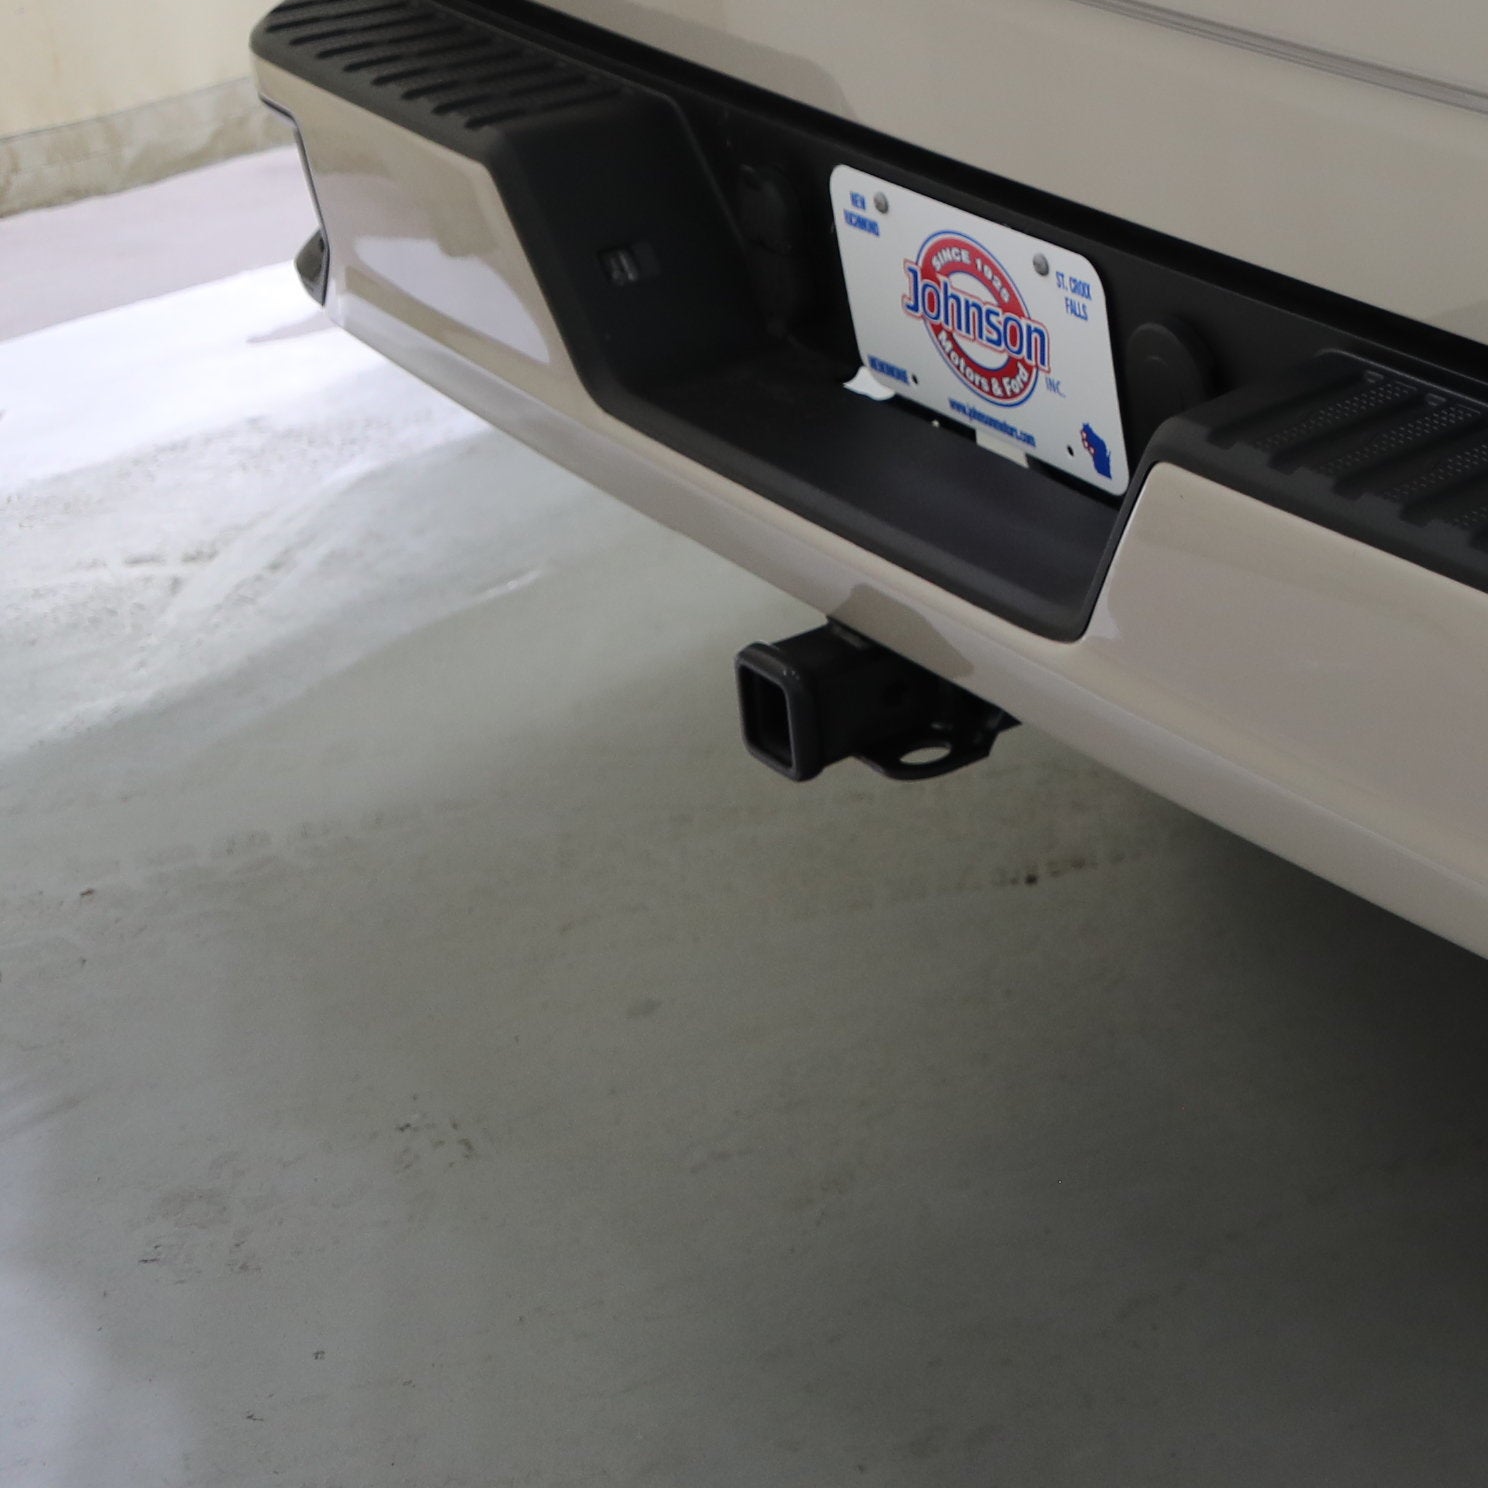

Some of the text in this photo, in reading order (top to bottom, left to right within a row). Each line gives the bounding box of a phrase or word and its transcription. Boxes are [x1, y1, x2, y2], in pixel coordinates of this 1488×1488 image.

[931, 246, 972, 272] SINCE
[1055, 270, 1068, 291] ST.
[902, 261, 1050, 372] Johnson
[1064, 296, 1089, 321] FALLS
[938, 330, 990, 393] Motors
[990, 377, 1004, 397] &
[1002, 362, 1030, 397] Ford
